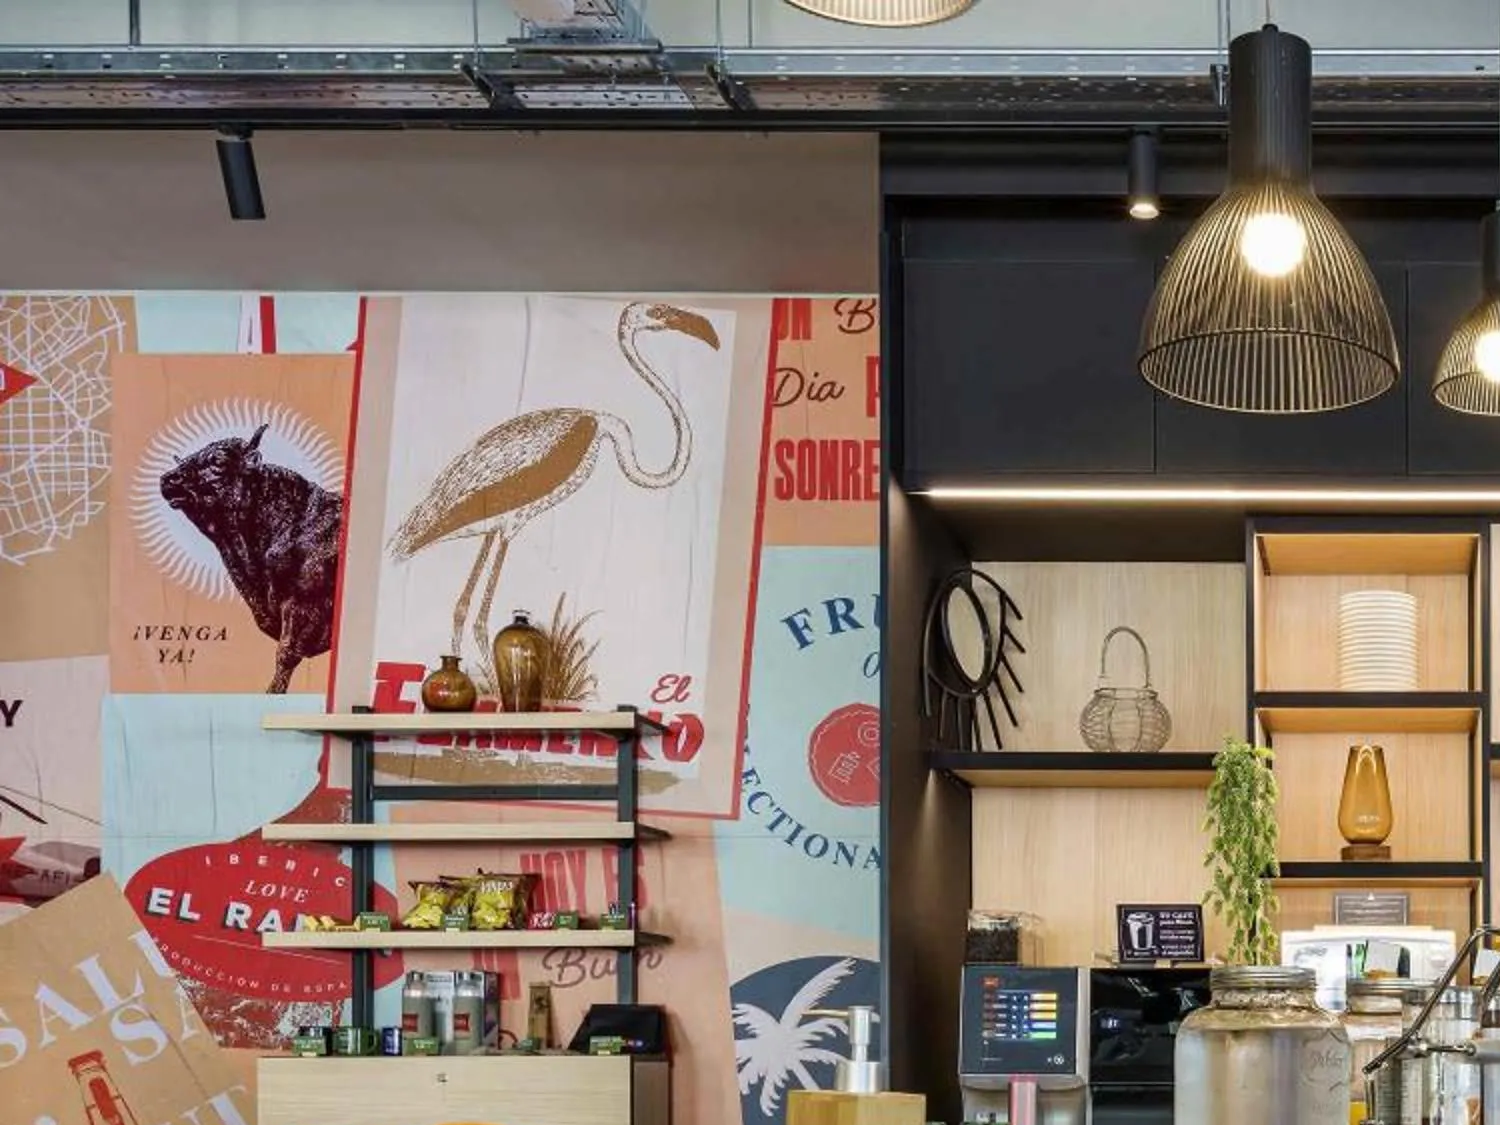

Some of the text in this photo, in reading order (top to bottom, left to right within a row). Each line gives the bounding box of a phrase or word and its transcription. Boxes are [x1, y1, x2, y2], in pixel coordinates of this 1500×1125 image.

[132, 624, 229, 642] ¡VENGA
[780, 592, 880, 651] FR
[156, 647, 196, 665] YA!
[650, 673, 691, 704] El
[244, 879, 309, 903] LOVE
[147, 887, 200, 923] EL
